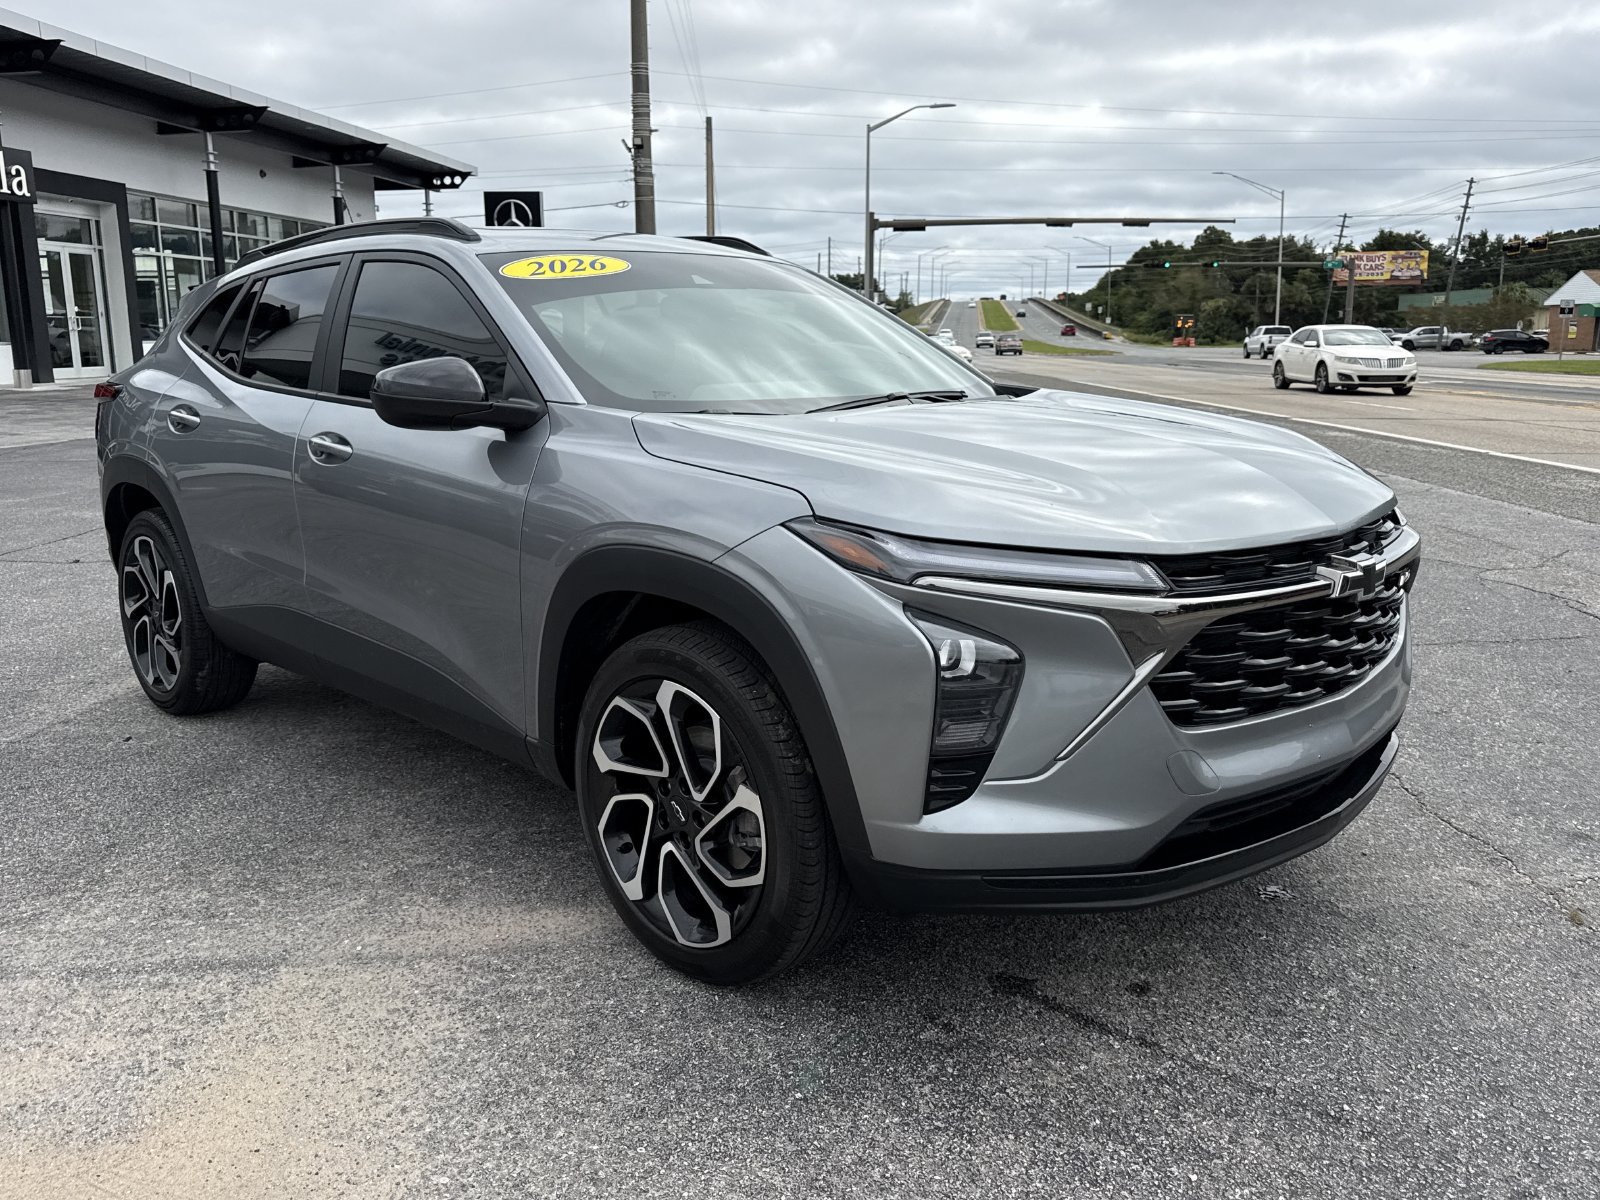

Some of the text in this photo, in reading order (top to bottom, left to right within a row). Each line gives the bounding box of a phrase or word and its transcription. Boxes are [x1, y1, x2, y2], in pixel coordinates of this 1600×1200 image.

[1366, 254, 1387, 262] BUYS
[527, 258, 606, 276] 2026
[1363, 263, 1384, 271] CARS
